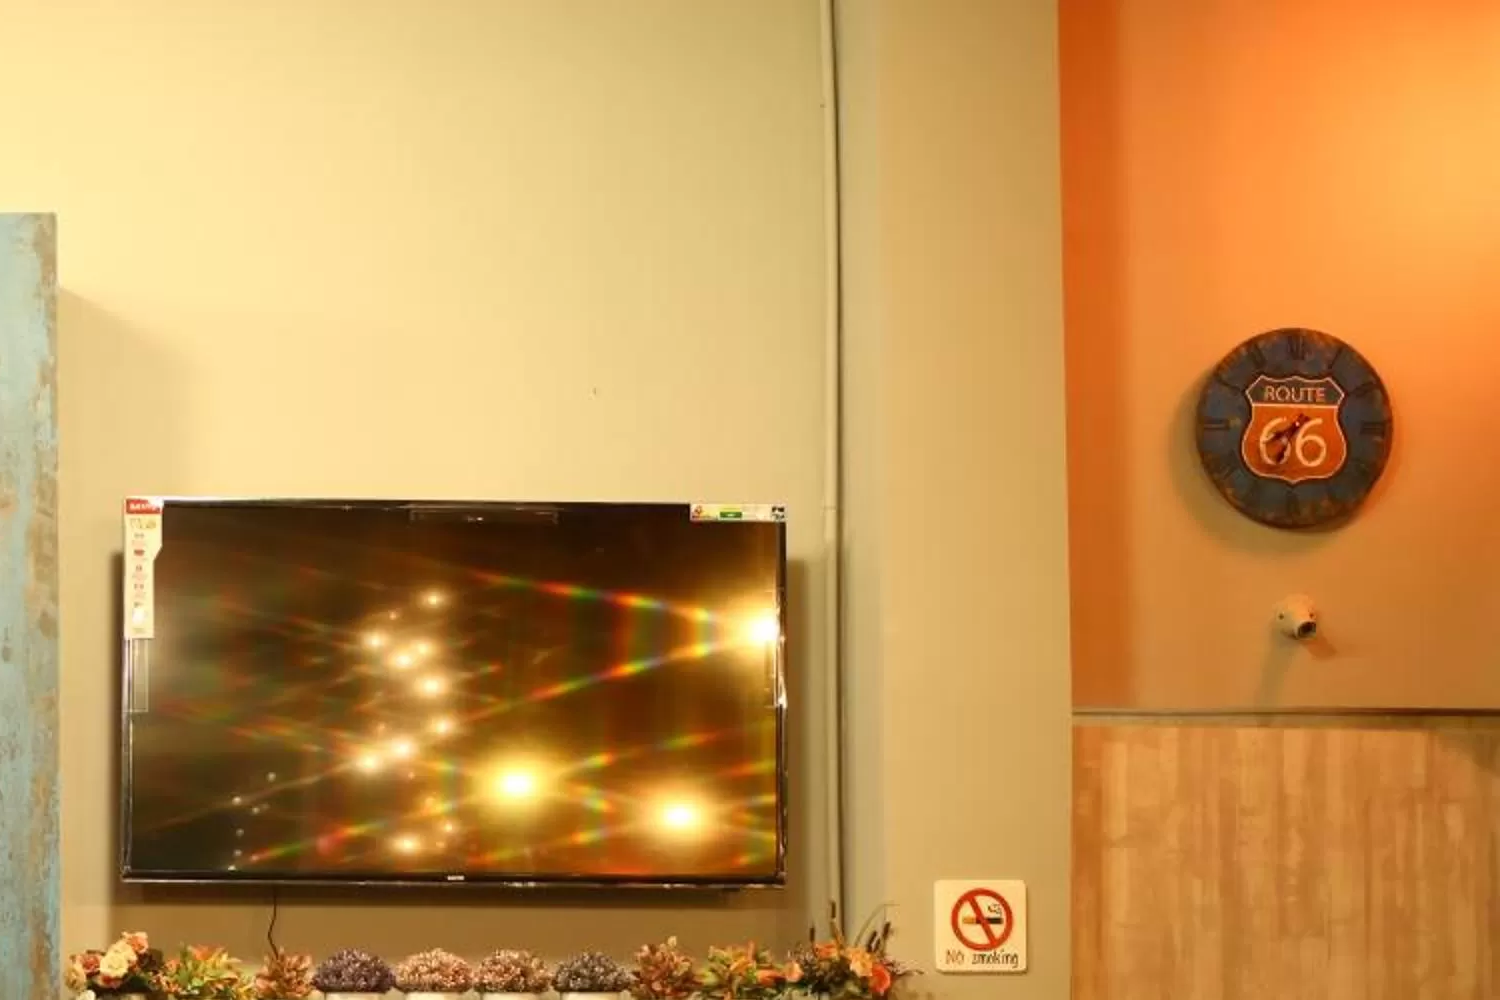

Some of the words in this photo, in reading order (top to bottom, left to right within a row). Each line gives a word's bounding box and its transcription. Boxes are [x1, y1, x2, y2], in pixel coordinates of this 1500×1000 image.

[1263, 385, 1327, 403] ROUTE
[1259, 417, 1327, 468] 66
[971, 949, 1019, 969] smoking
